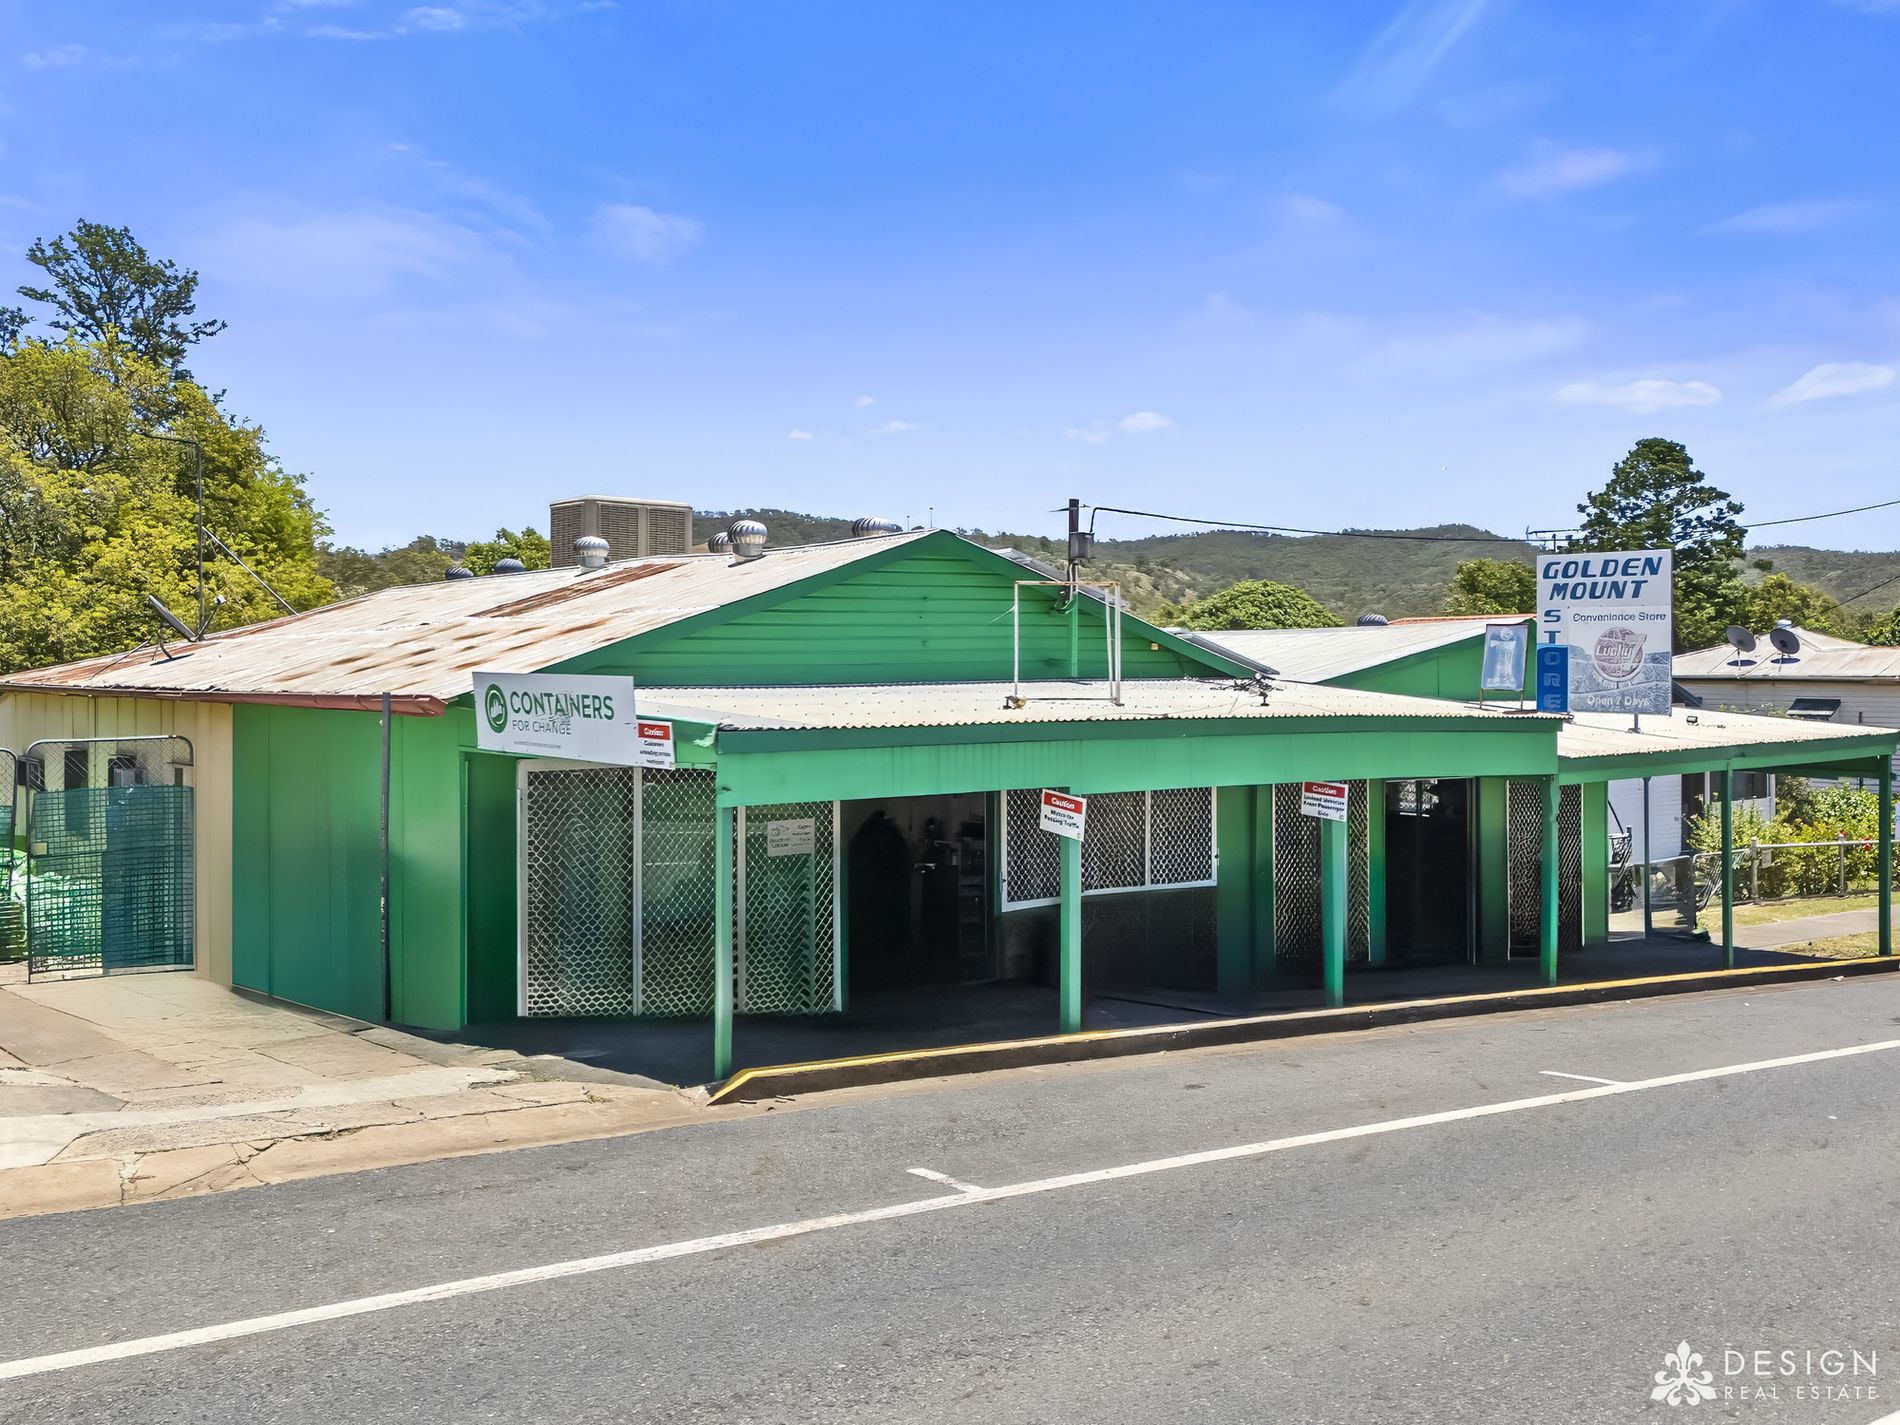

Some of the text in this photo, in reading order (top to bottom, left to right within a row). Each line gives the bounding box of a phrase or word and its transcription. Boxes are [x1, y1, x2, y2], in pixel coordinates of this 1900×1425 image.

[1543, 557, 1662, 580] GOLDEN
[1549, 580, 1648, 601] MOUNT
[1573, 612, 1666, 622] Convenience Store
[1543, 609, 1562, 709] STORE
[510, 691, 614, 720] CONTAINERS
[1587, 694, 1613, 706] Open
[512, 720, 572, 735] FOR CHANGE
[1312, 785, 1337, 795] Caution
[1051, 797, 1075, 809] Caution
